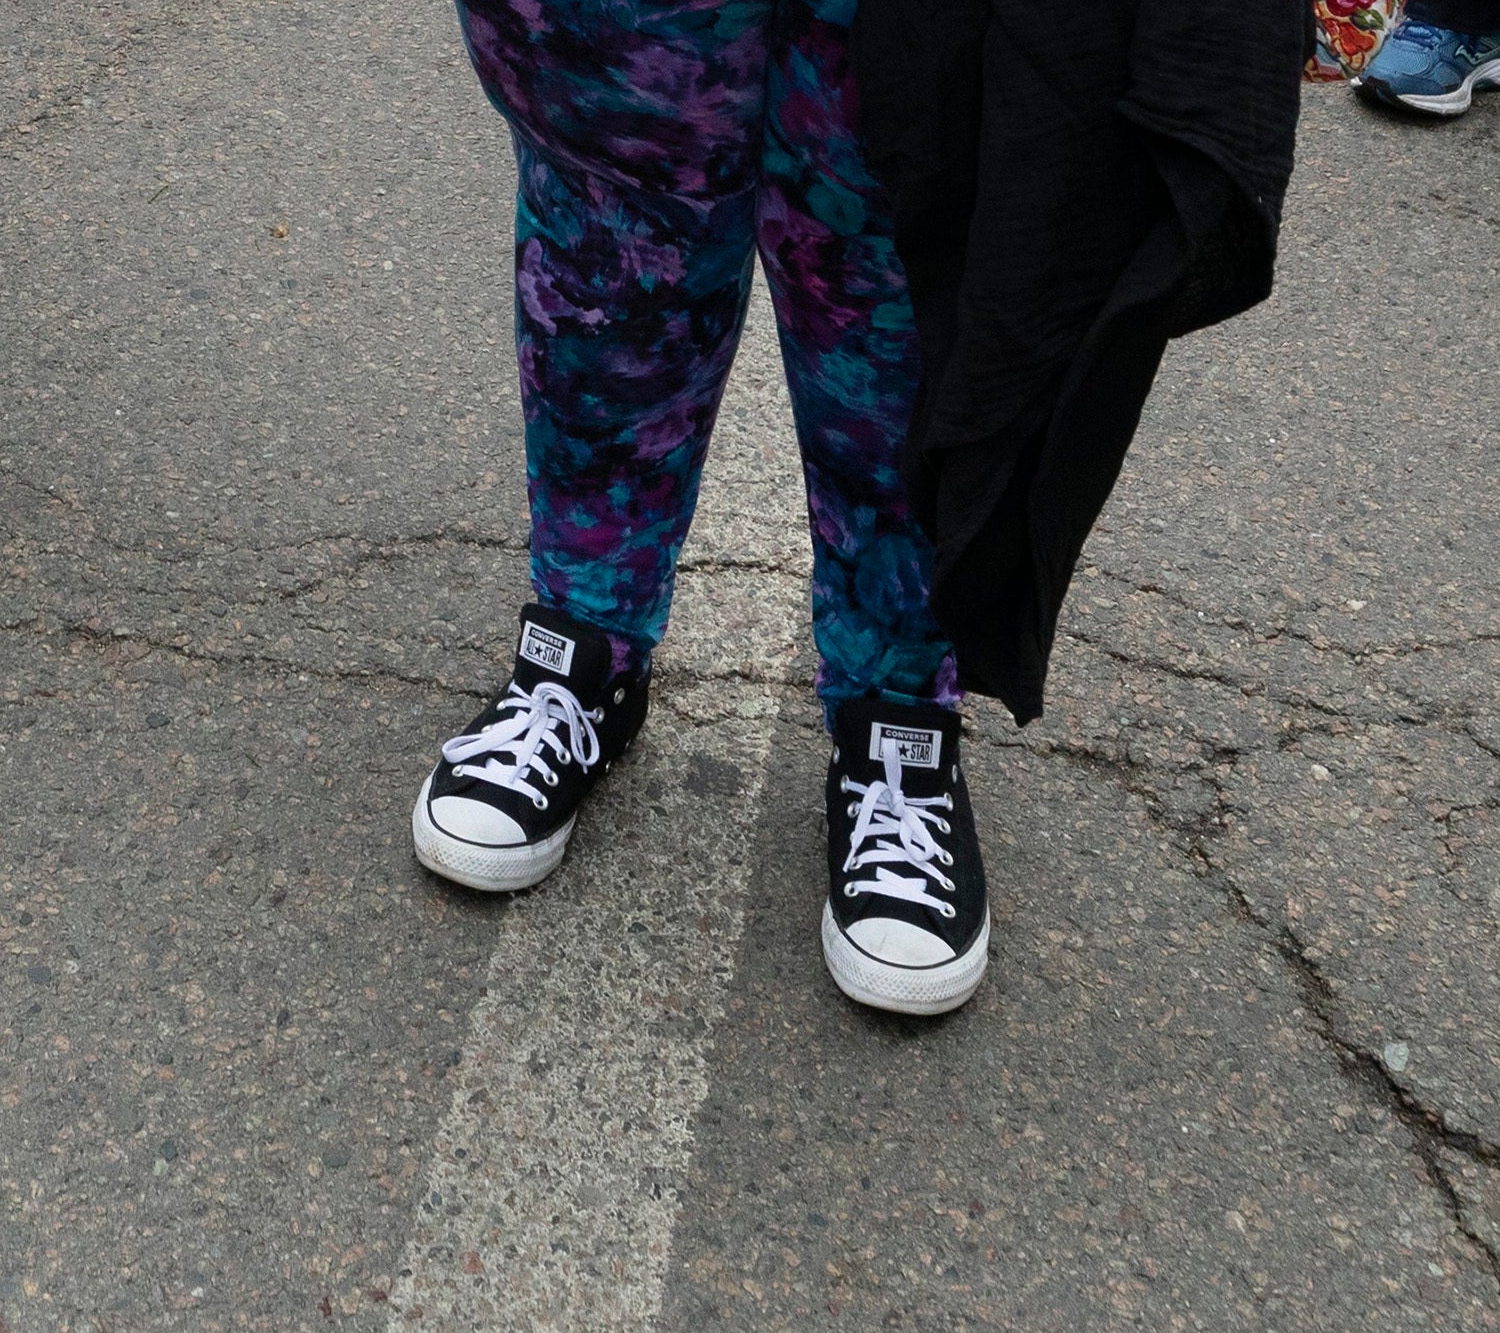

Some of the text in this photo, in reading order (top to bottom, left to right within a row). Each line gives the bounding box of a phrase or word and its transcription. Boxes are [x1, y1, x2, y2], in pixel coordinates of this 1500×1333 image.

[531, 629, 563, 649] CONVERSE
[542, 646, 562, 667] STAR
[885, 729, 930, 742] CONVERSE
[910, 744, 931, 761] STAR
